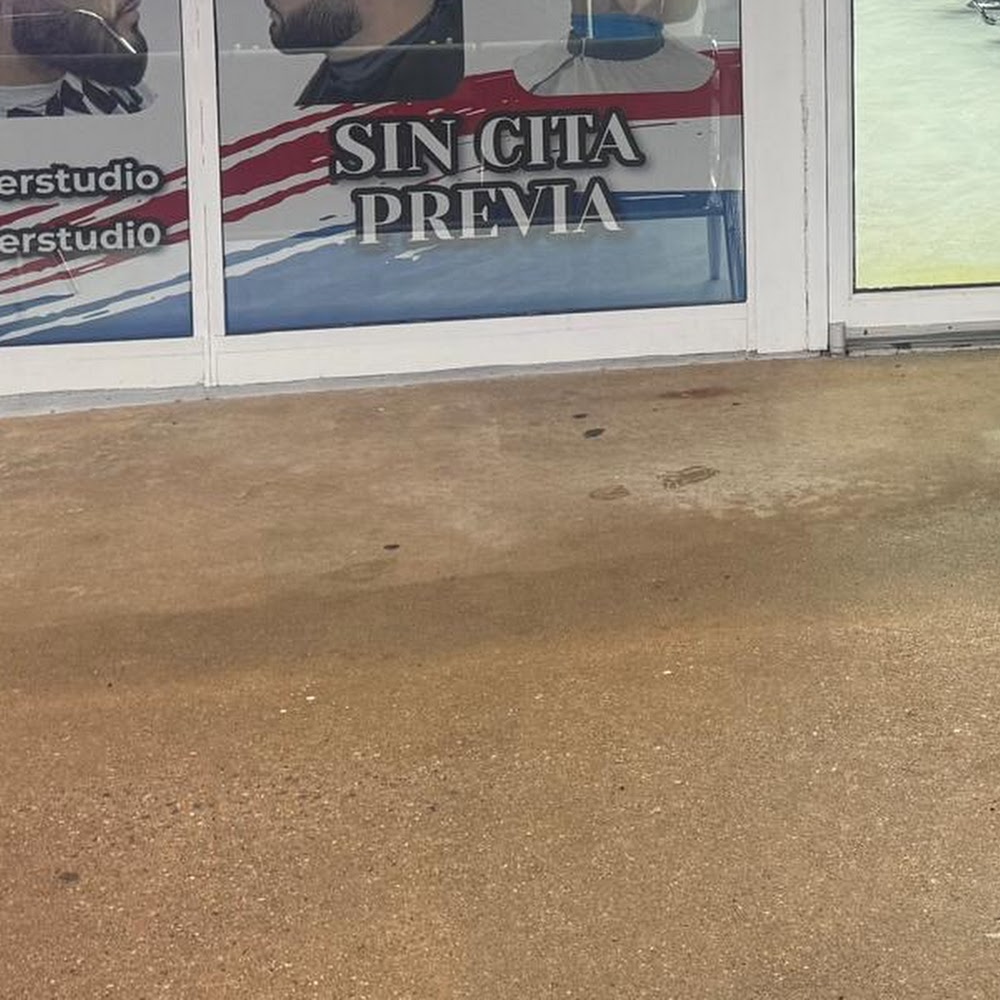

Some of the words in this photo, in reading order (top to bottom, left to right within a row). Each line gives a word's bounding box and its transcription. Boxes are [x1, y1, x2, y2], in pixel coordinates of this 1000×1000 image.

[334, 115, 457, 176] SIN
[479, 111, 641, 171] CITA
[0, 162, 160, 196] erstudio
[357, 181, 622, 245] PREVIA
